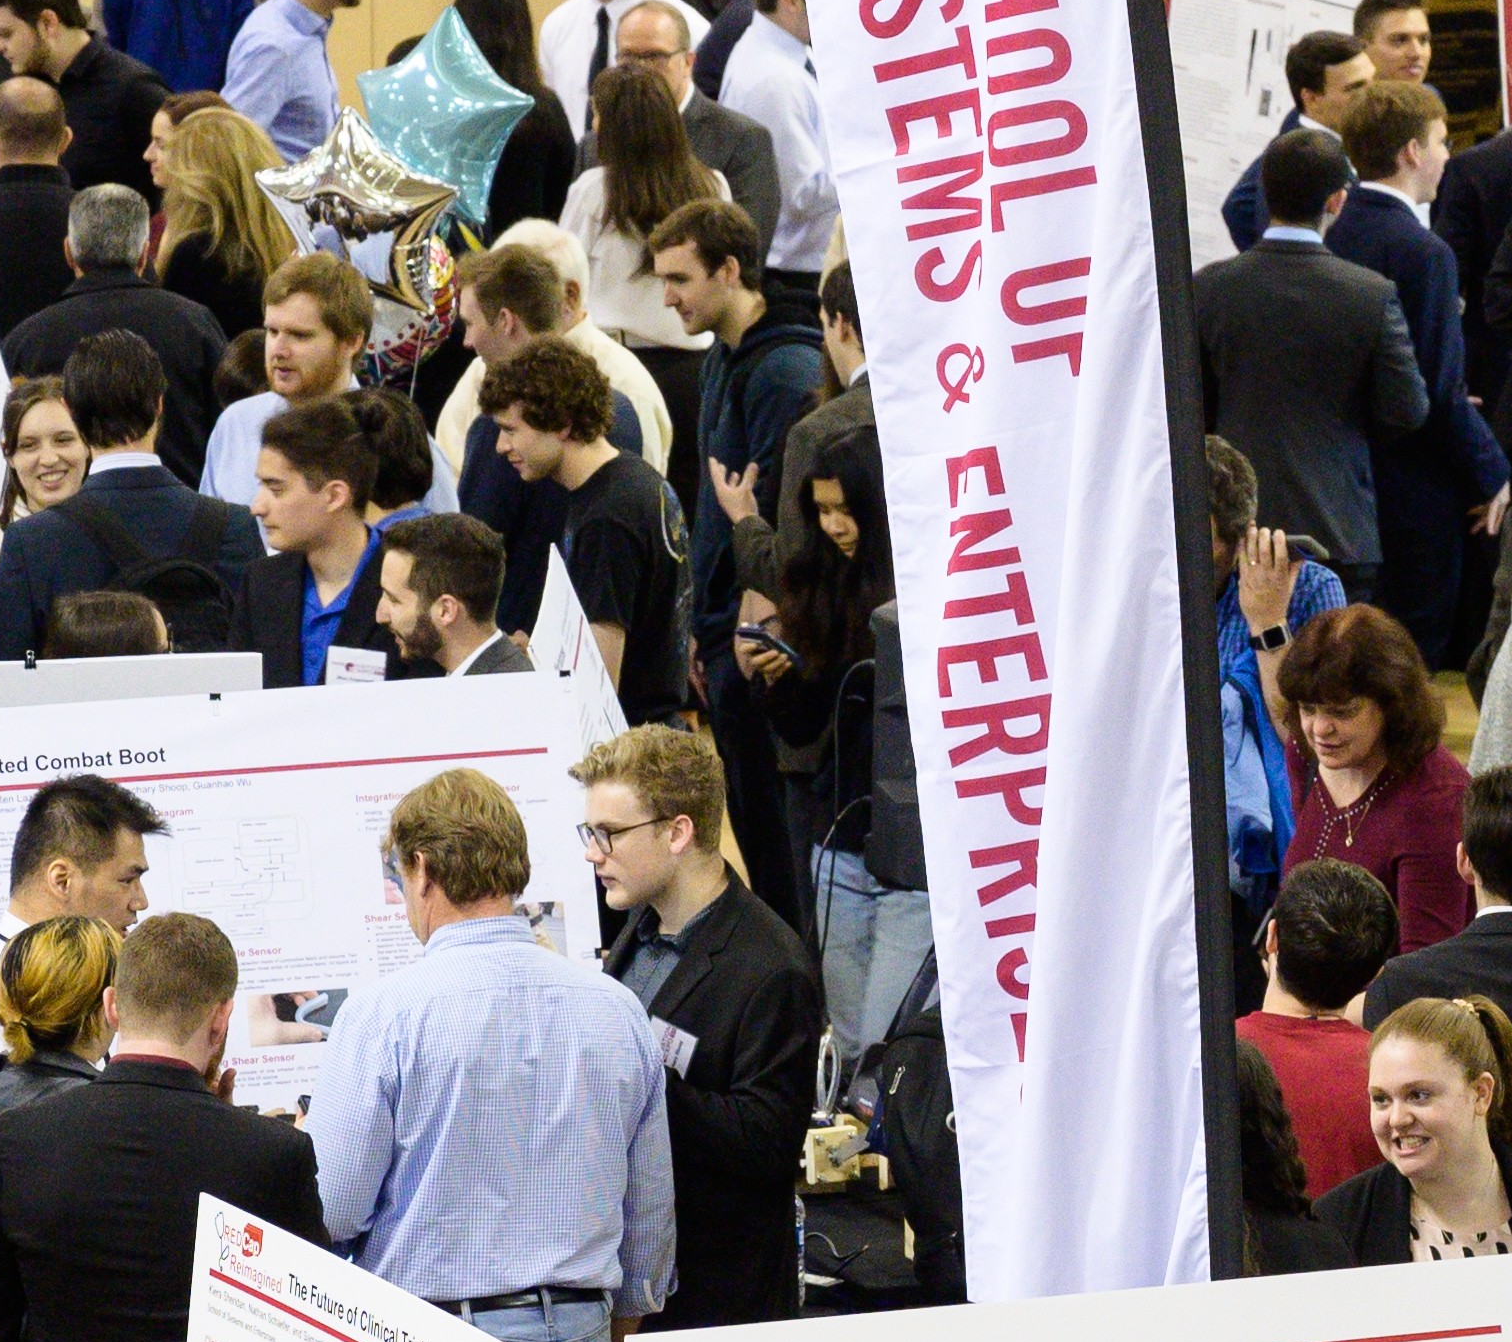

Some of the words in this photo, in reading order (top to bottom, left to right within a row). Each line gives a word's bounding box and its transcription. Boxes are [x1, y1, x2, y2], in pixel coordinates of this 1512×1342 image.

[936, 344, 985, 413] &
[35, 750, 112, 772] Combat
[119, 747, 166, 765] Boot
[229, 1254, 282, 1294] Reimagined
[289, 1273, 307, 1301] The
[310, 1284, 344, 1320] Future
[347, 1307, 358, 1325] of
